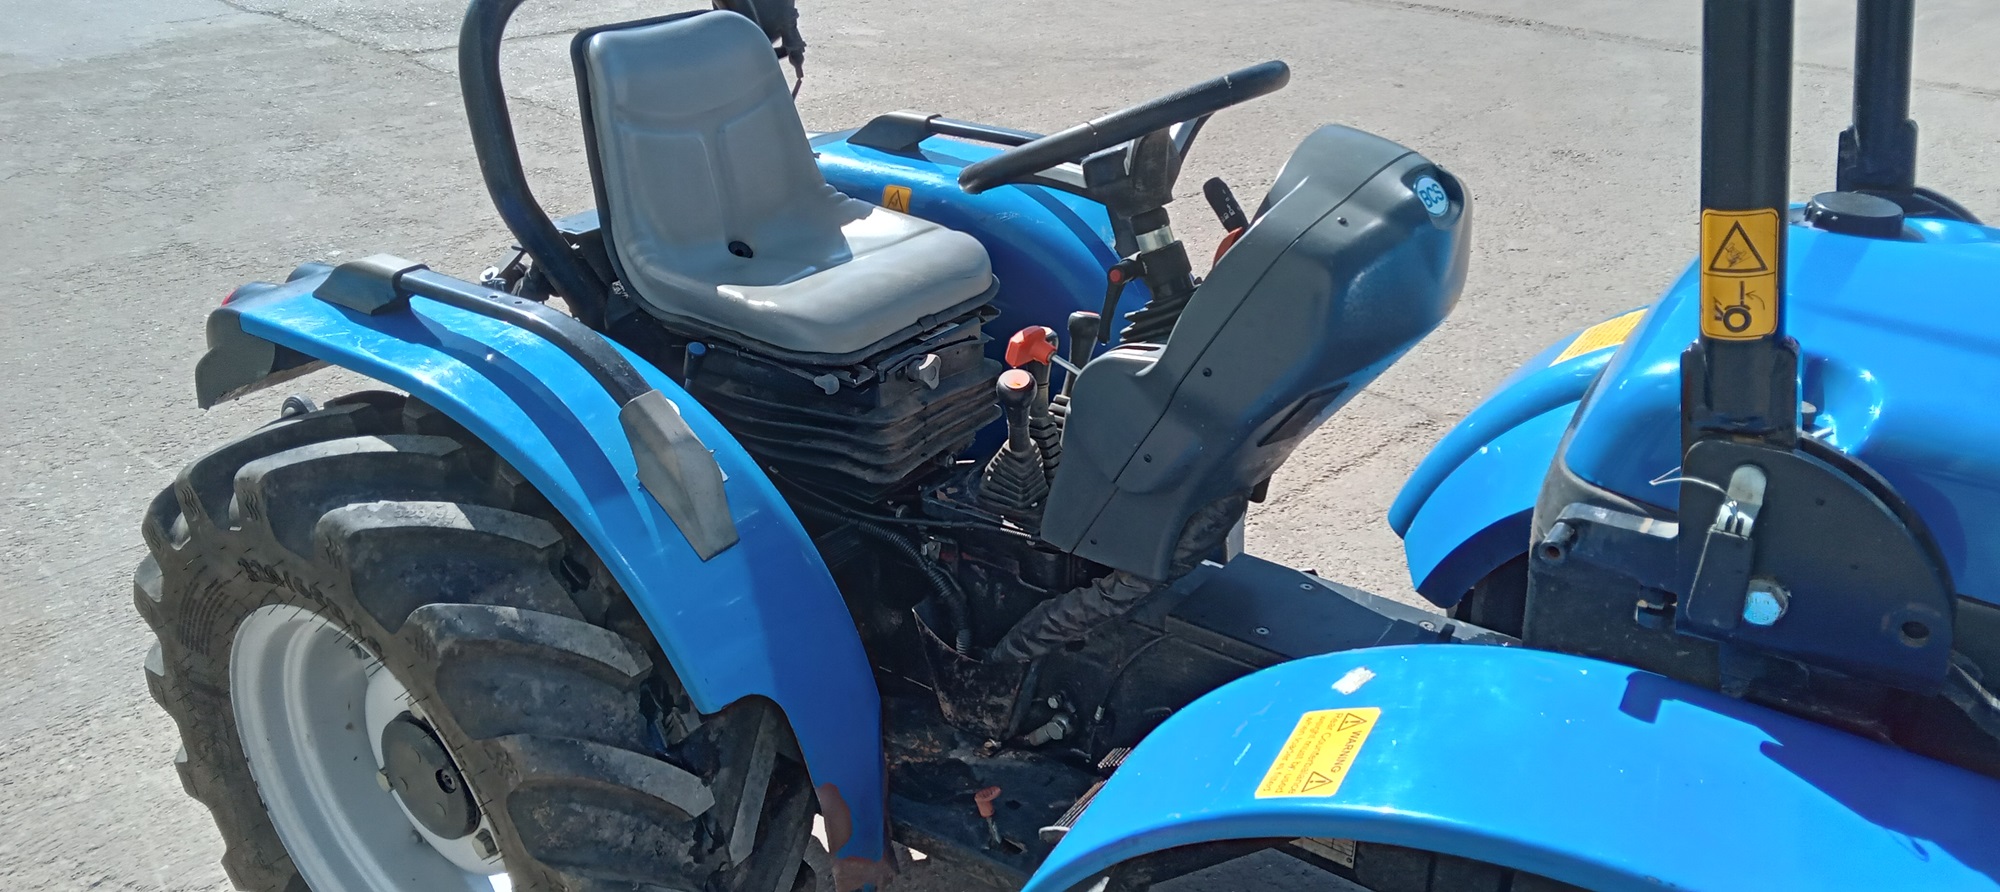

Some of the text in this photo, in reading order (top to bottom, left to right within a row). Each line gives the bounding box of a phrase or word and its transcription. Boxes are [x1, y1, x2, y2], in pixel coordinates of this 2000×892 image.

[1419, 183, 1444, 209] BCS
[1288, 712, 1344, 794] Rear Counterbalance
[1330, 730, 1363, 773] WARNING
